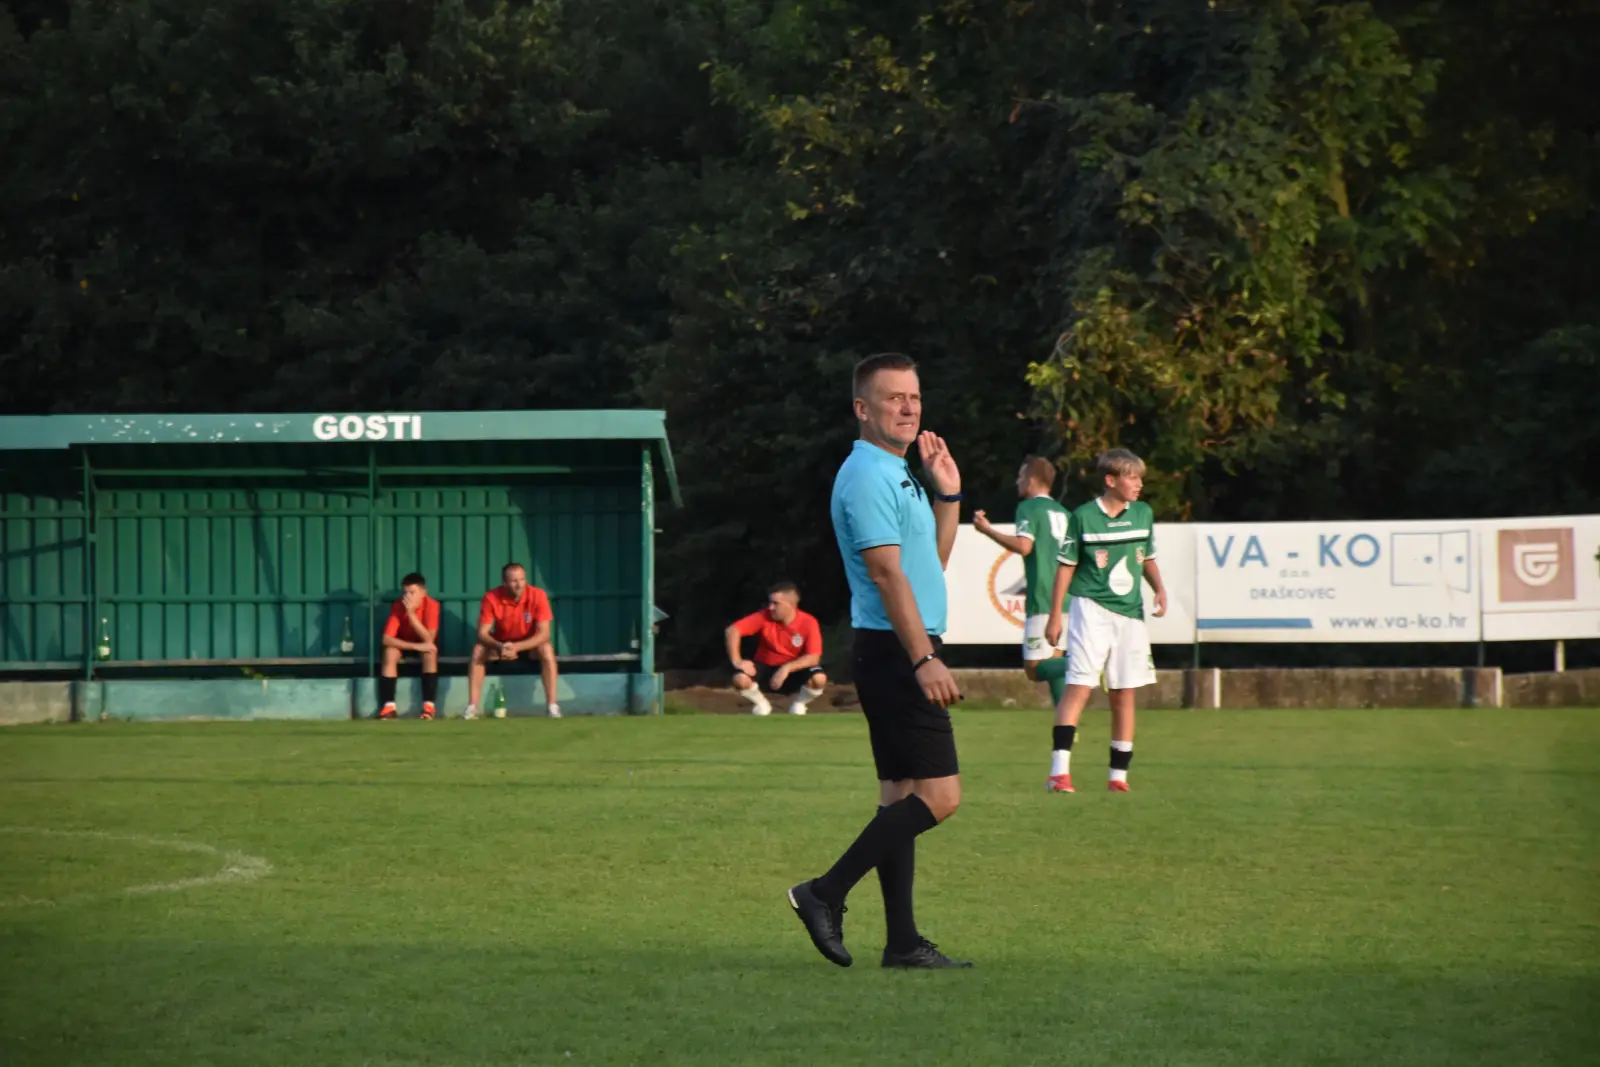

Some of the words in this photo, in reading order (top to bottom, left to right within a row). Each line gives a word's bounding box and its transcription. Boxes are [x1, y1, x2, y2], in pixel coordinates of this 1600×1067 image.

[313, 414, 422, 441] GOSTI
[1207, 535, 1269, 568] VA
[1318, 533, 1381, 568] KO
[1250, 586, 1336, 600] DRAŠKOVEC
[1329, 612, 1468, 630] www.va-ko.hr
